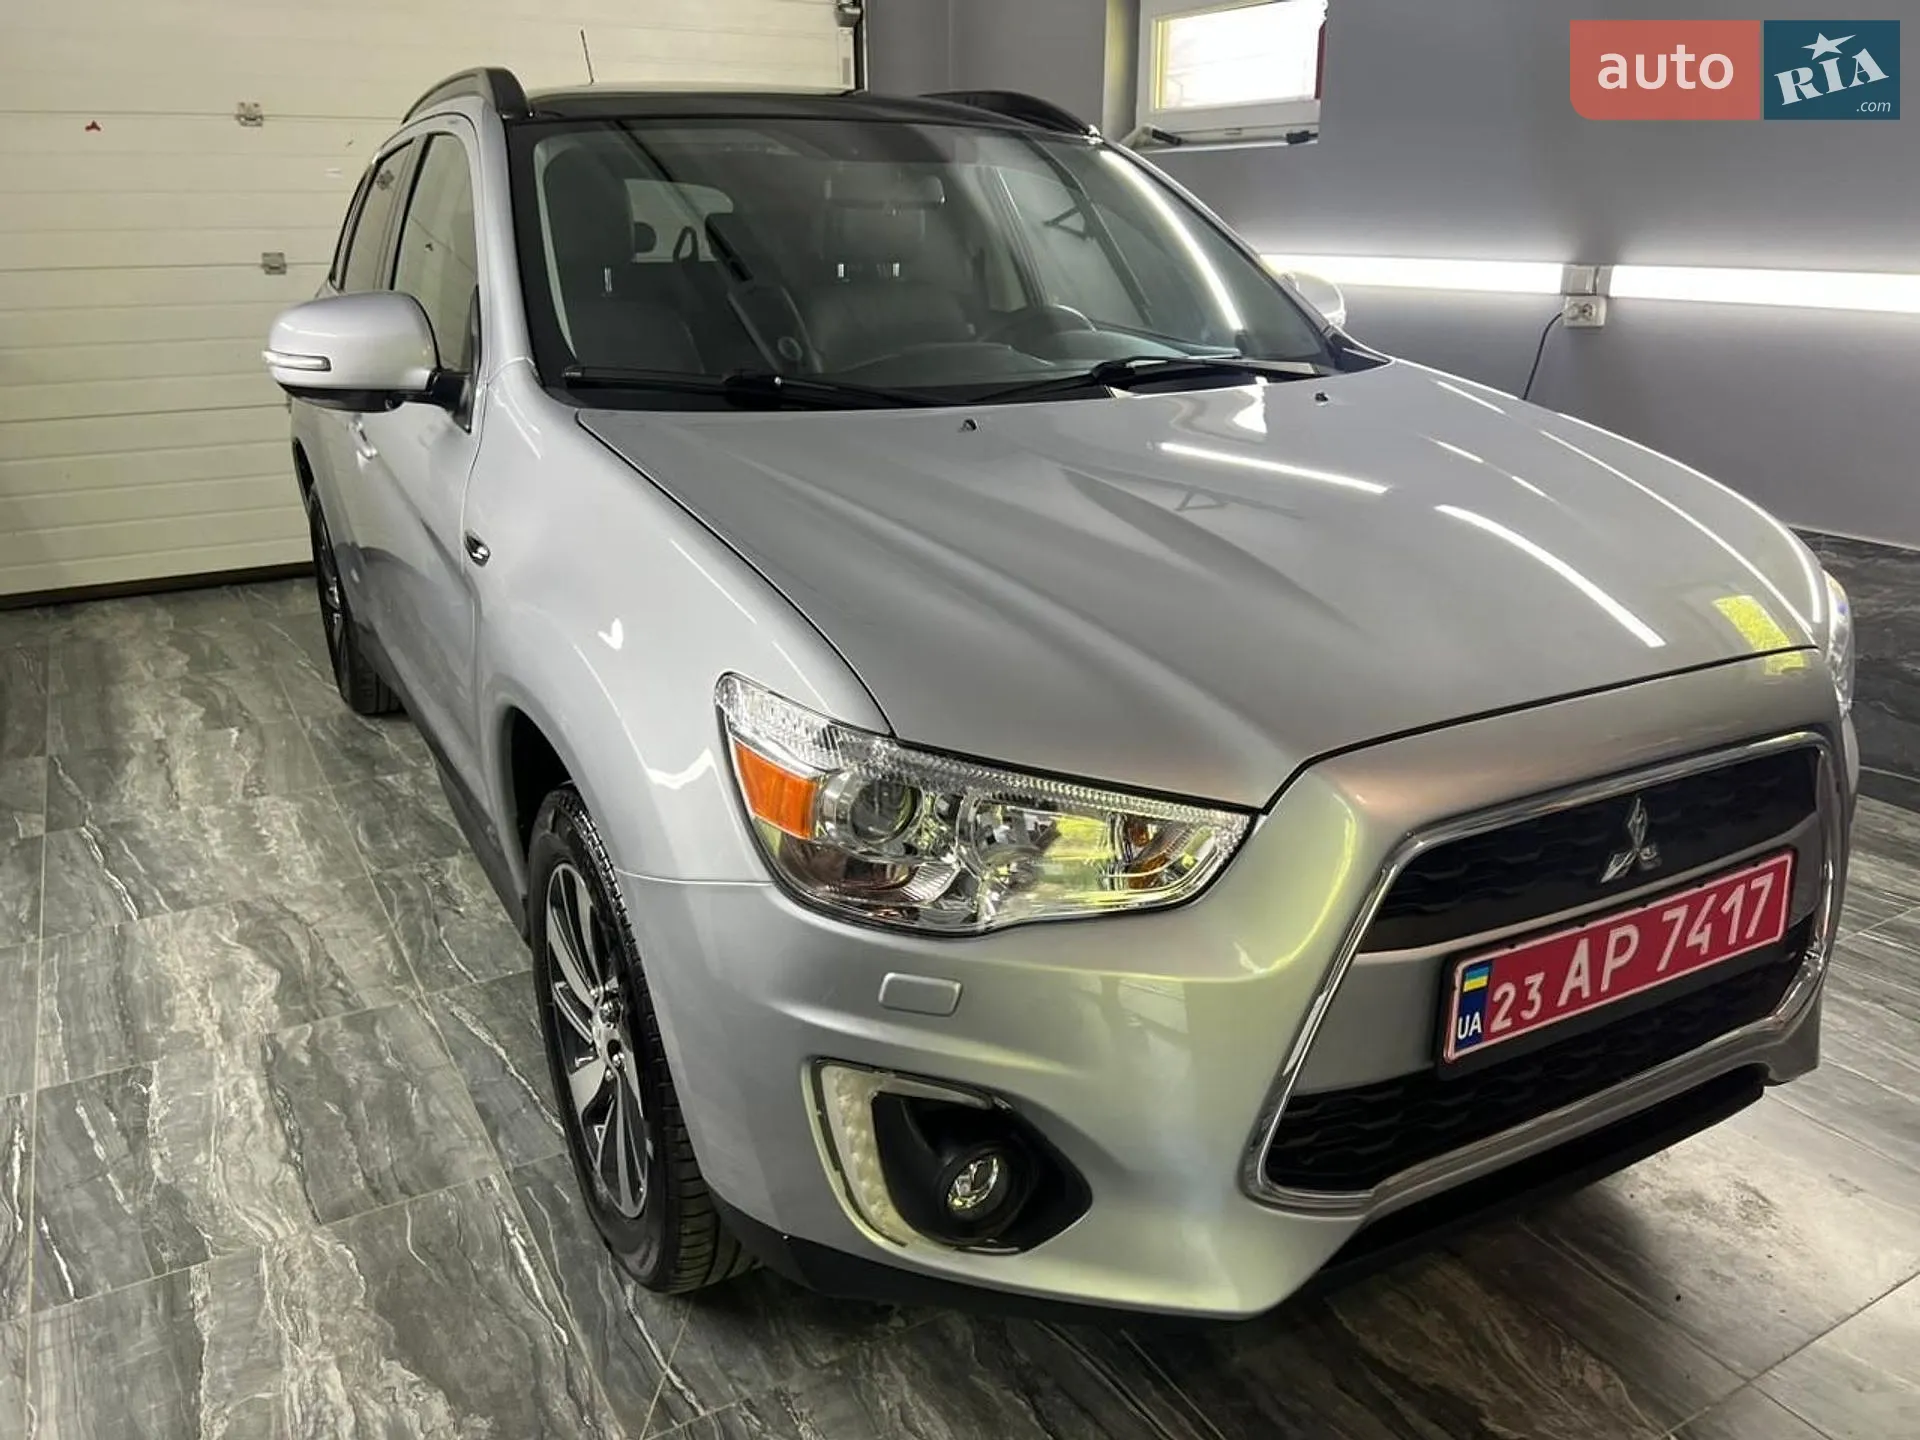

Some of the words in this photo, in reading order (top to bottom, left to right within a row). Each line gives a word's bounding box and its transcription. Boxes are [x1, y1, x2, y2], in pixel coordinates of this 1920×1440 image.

[1490, 971, 1545, 1033] 23
[1557, 924, 1640, 1008] AP
[1656, 872, 1775, 973] 7417
[1457, 1011, 1483, 1041] UA
